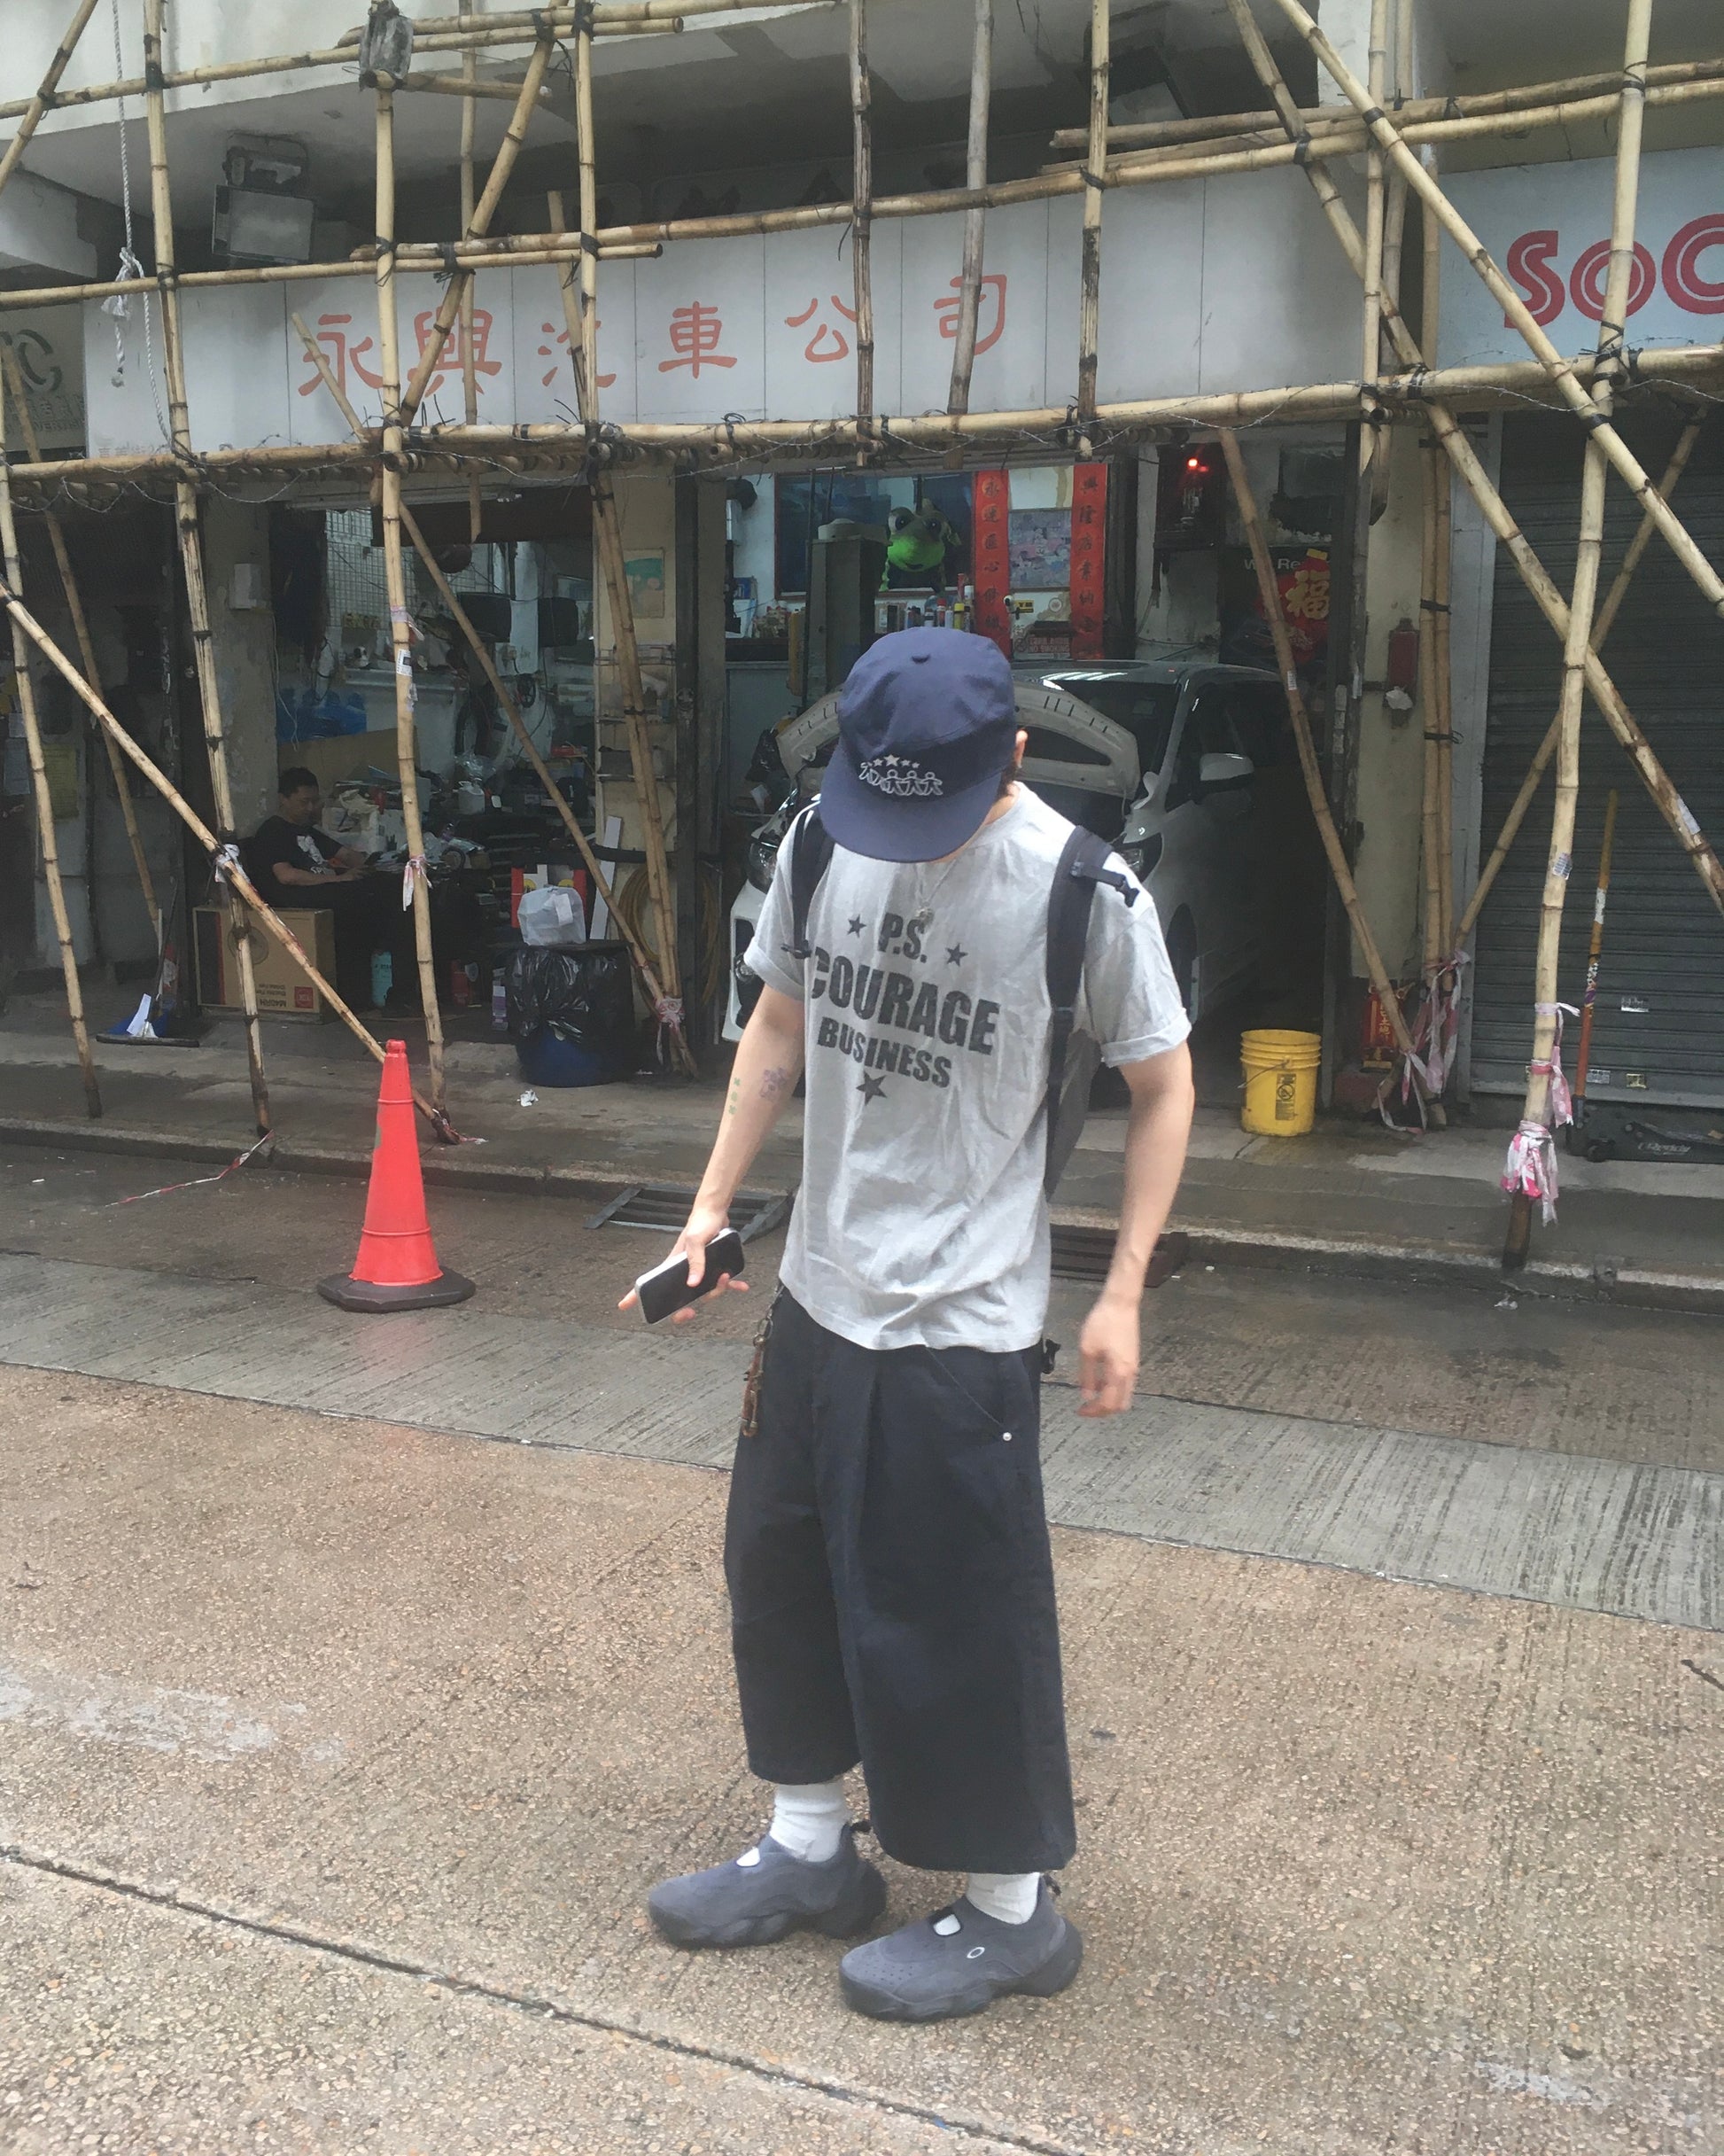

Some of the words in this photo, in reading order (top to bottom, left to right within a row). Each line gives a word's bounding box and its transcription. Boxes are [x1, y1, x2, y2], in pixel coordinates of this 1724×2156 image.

[878, 912, 928, 963] P.S.
[812, 946, 999, 1055] COURAGE
[817, 1016, 952, 1088] BUSINESS
